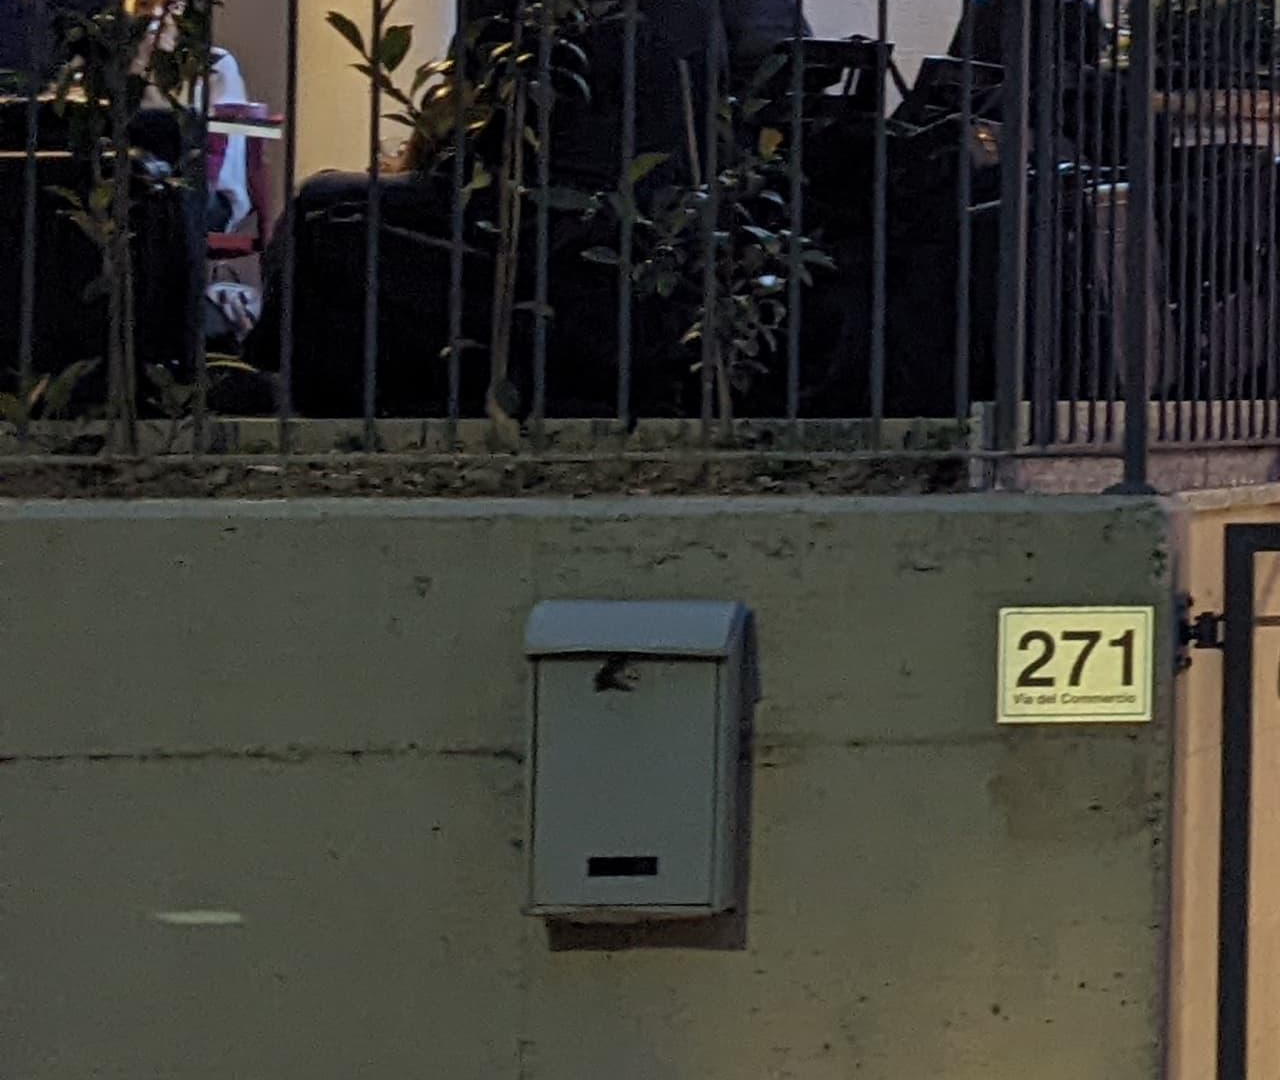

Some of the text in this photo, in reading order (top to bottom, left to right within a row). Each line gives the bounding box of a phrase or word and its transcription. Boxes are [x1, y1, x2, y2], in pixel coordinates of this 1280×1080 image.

[1015, 629, 1136, 688] 271
[1013, 693, 1034, 705] Via
[1060, 692, 1137, 705] Commercio
